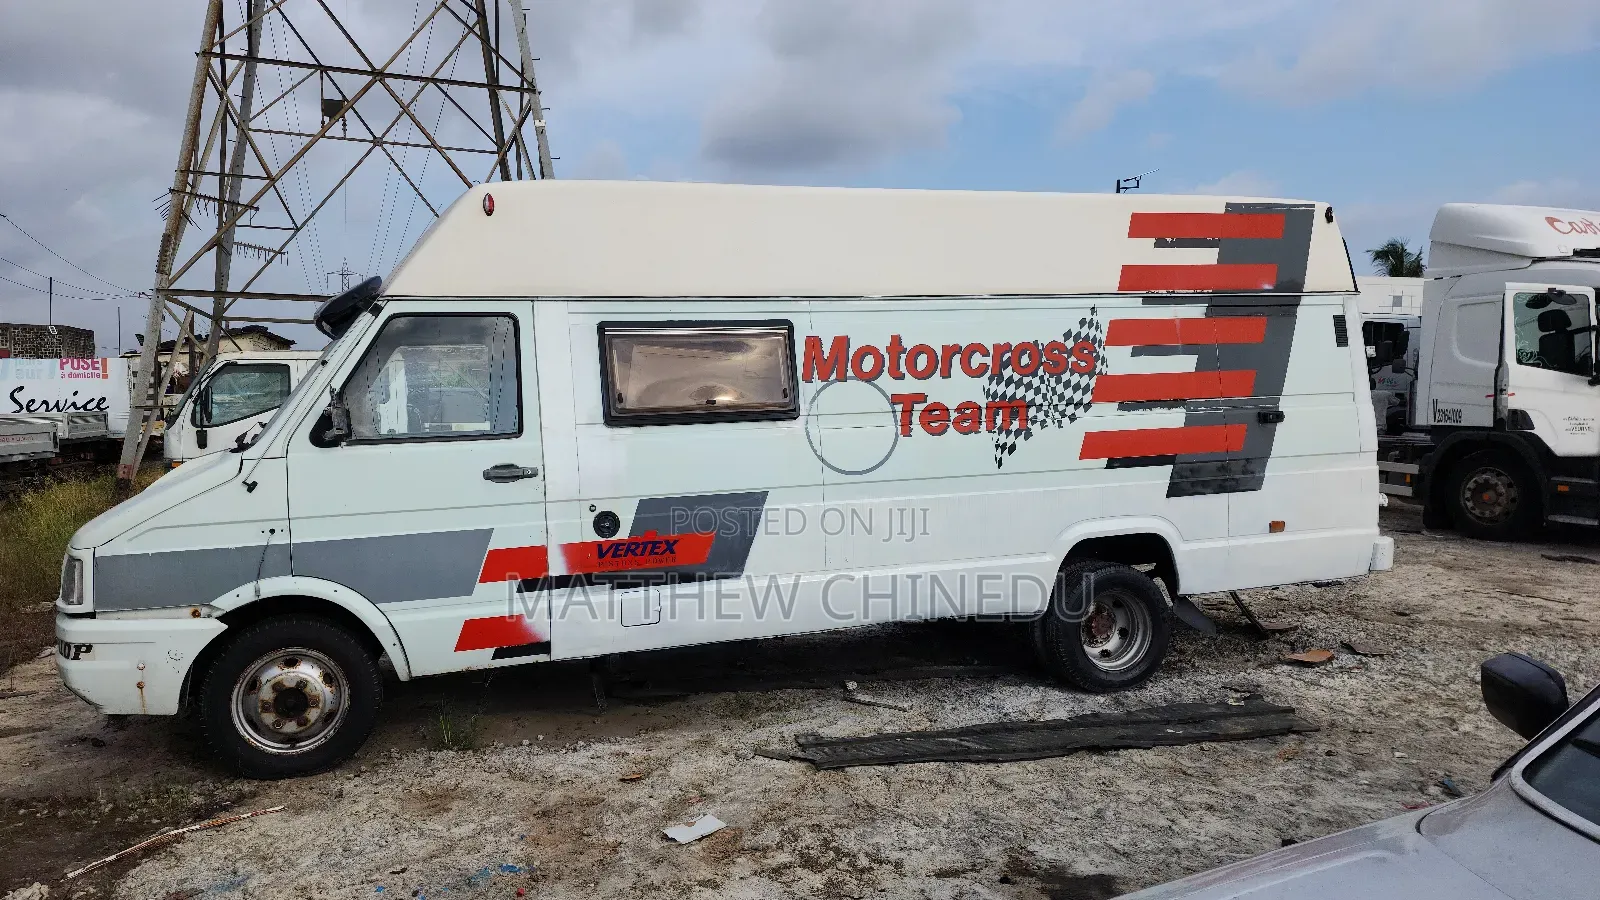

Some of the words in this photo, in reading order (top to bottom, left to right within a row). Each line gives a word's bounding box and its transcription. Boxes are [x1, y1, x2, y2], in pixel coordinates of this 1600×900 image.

[802, 334, 1098, 382] Motorcross
[10, 386, 109, 413] Service
[891, 393, 1028, 437] Team
[597, 539, 679, 559] VERTEX
